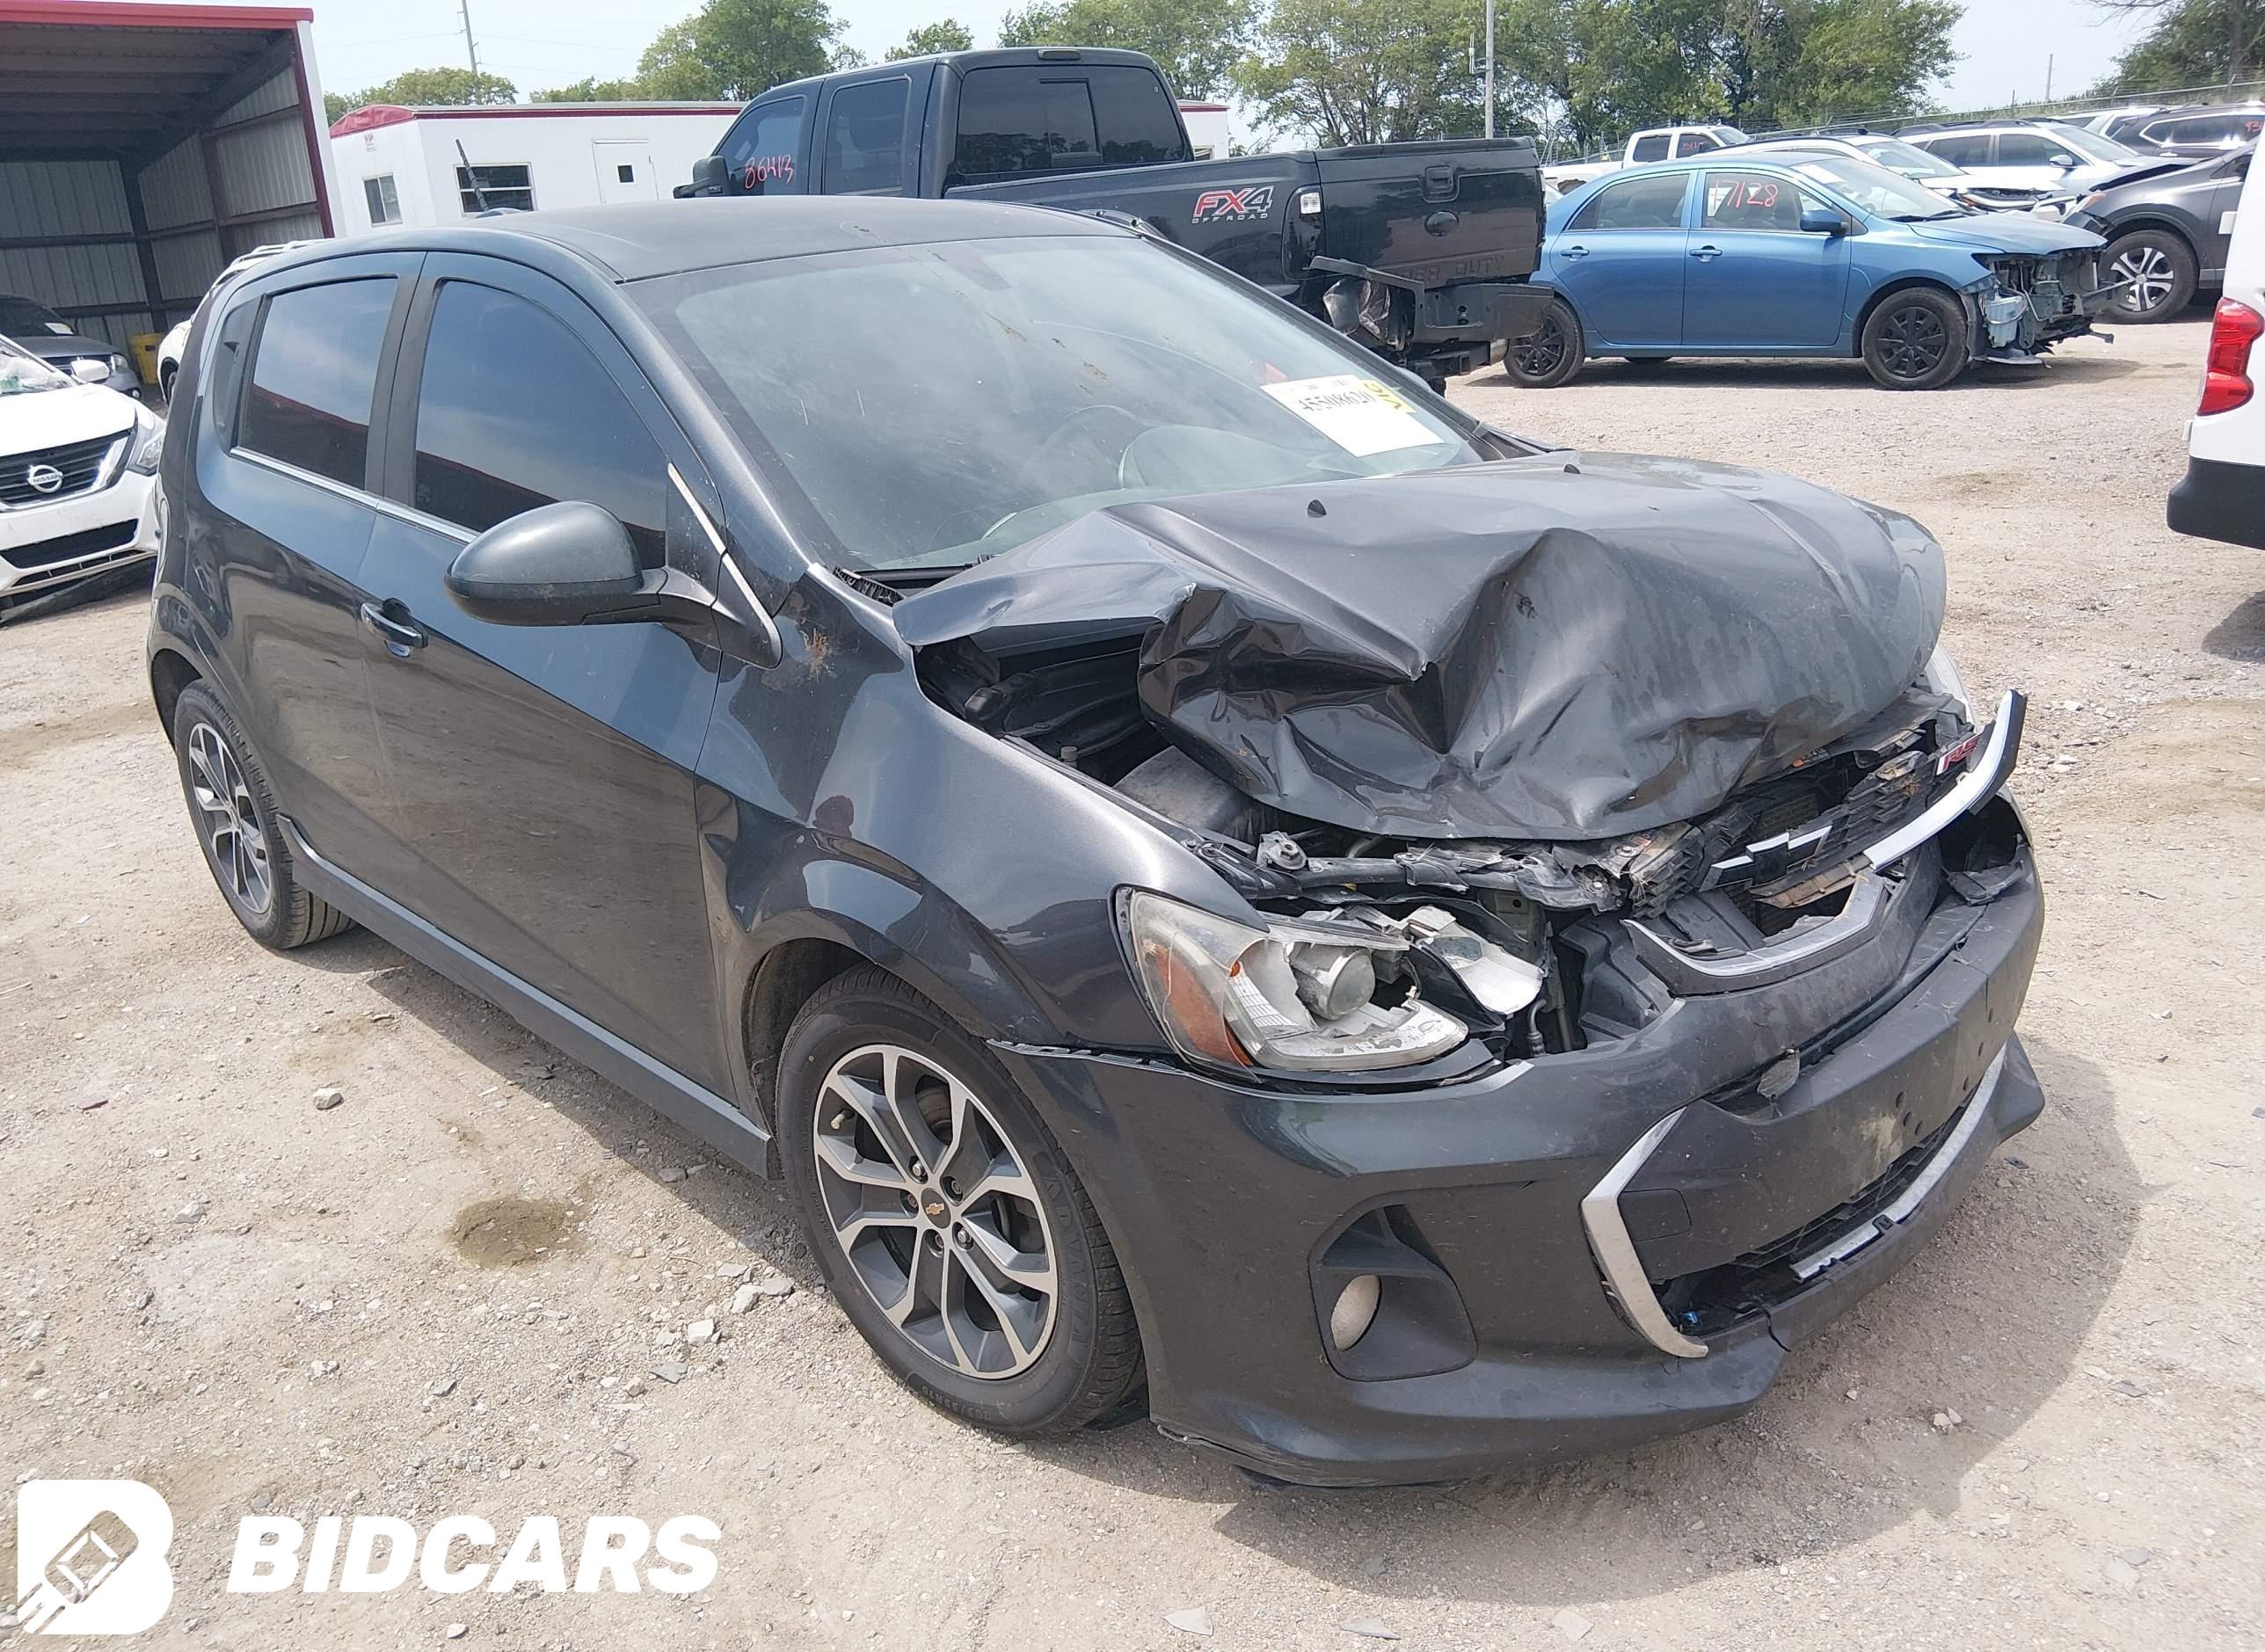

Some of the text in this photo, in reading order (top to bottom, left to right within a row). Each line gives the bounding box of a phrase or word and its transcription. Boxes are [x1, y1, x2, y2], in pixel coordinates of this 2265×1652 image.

[746, 154, 793, 188] 86413
[1193, 186, 1274, 217] FX4
[1714, 180, 1778, 211] 17128
[1455, 255, 1504, 275] DUTY
[33, 473, 62, 484] NISSAN
[1936, 732, 1984, 775] RS
